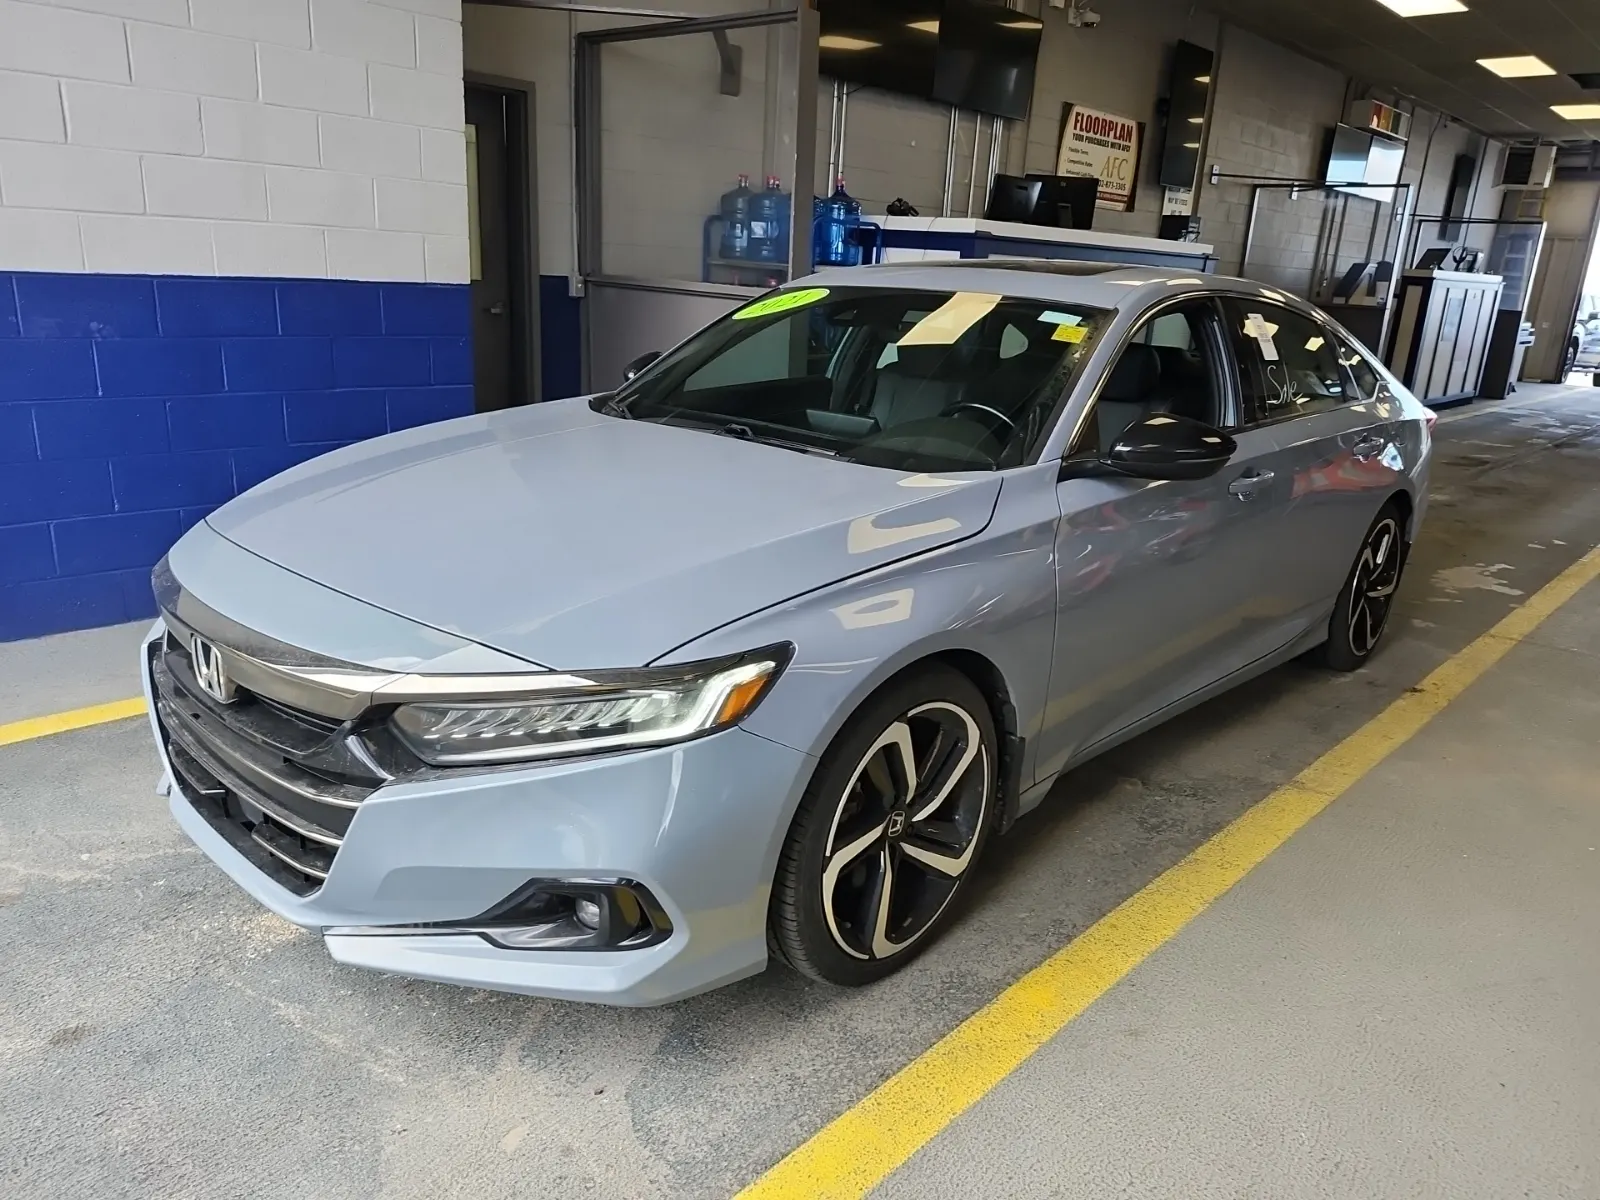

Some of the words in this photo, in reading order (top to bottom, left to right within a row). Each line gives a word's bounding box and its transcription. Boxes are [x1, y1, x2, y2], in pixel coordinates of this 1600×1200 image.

[1074, 112, 1133, 143] FLOORPLAN
[1073, 133, 1084, 142] YOUR
[1085, 136, 1109, 148] PURCHASES
[1110, 141, 1121, 150] WITH
[1100, 155, 1128, 181] AFC
